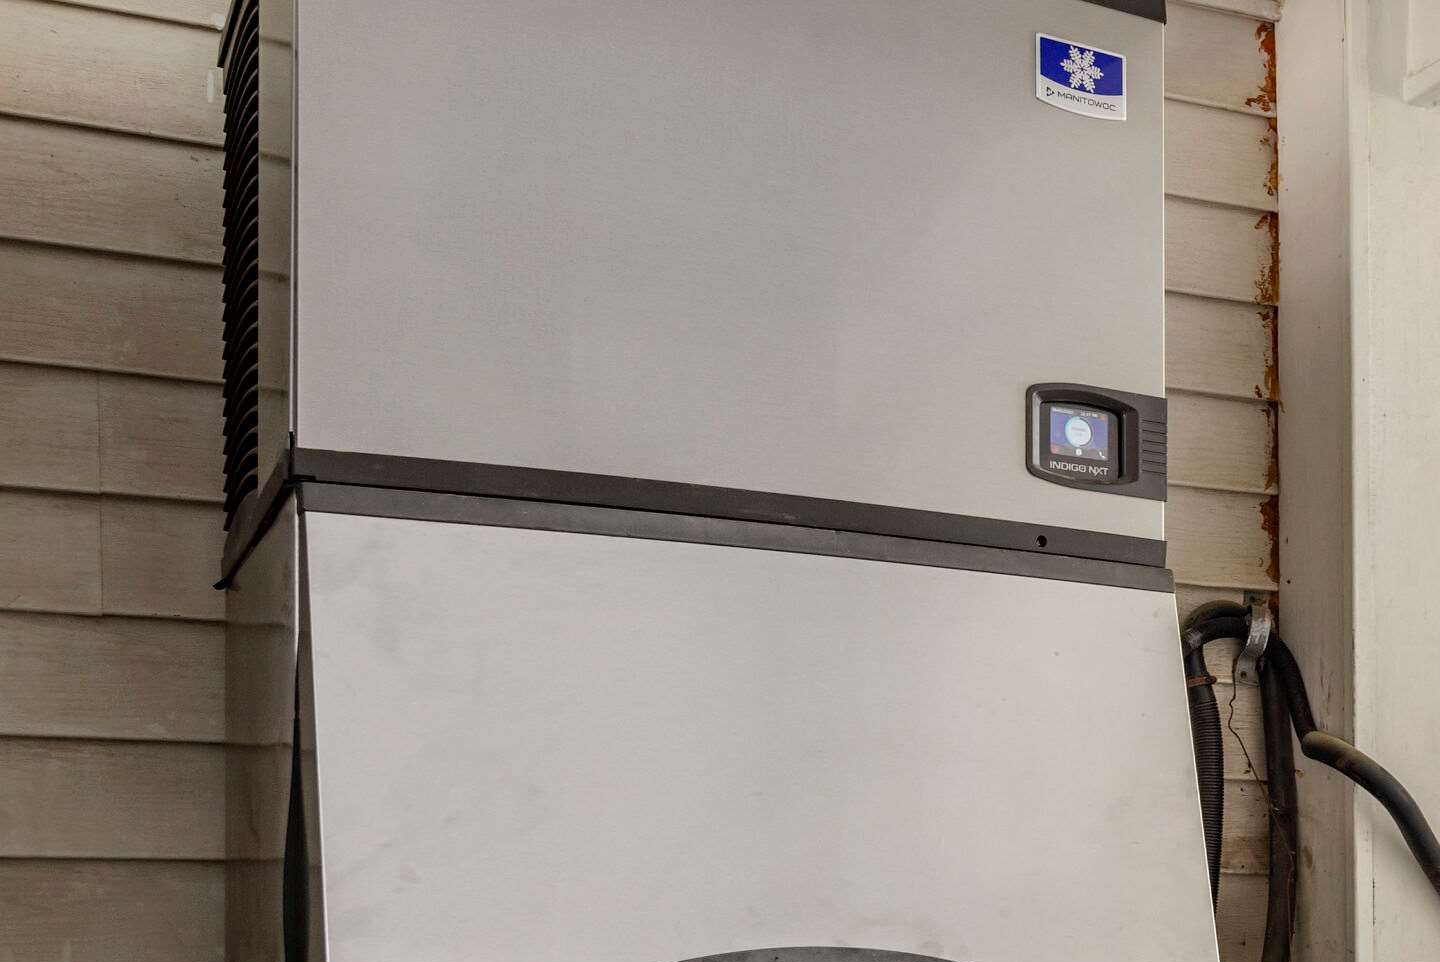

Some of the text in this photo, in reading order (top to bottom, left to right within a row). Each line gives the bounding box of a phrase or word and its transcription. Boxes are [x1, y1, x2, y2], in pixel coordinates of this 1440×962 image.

[1057, 91, 1117, 111] MANITOWOC
[1050, 460, 1109, 476] INDIGO NXT
